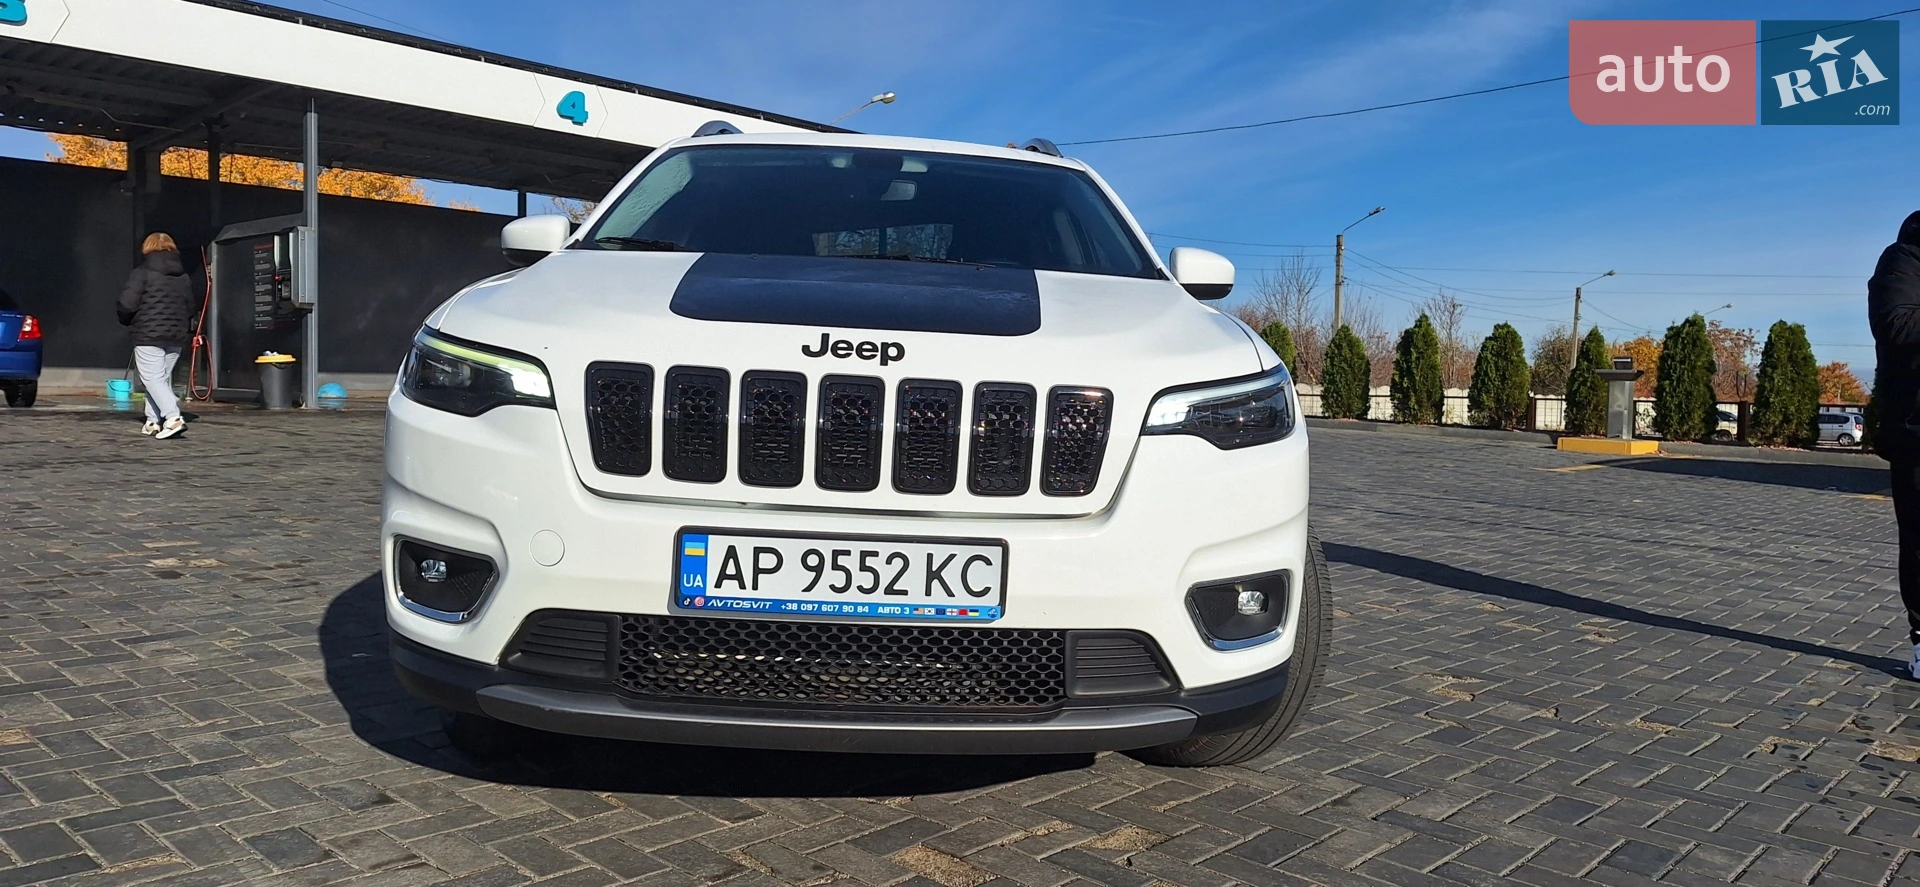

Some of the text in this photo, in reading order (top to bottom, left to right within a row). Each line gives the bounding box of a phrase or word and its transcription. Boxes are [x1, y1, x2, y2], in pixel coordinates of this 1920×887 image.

[557, 91, 588, 126] 4
[802, 333, 905, 366] Jeep
[683, 574, 704, 588] UA
[714, 545, 993, 597] AP 9552 KC
[780, 603, 870, 614] +38 097 607 90 84
